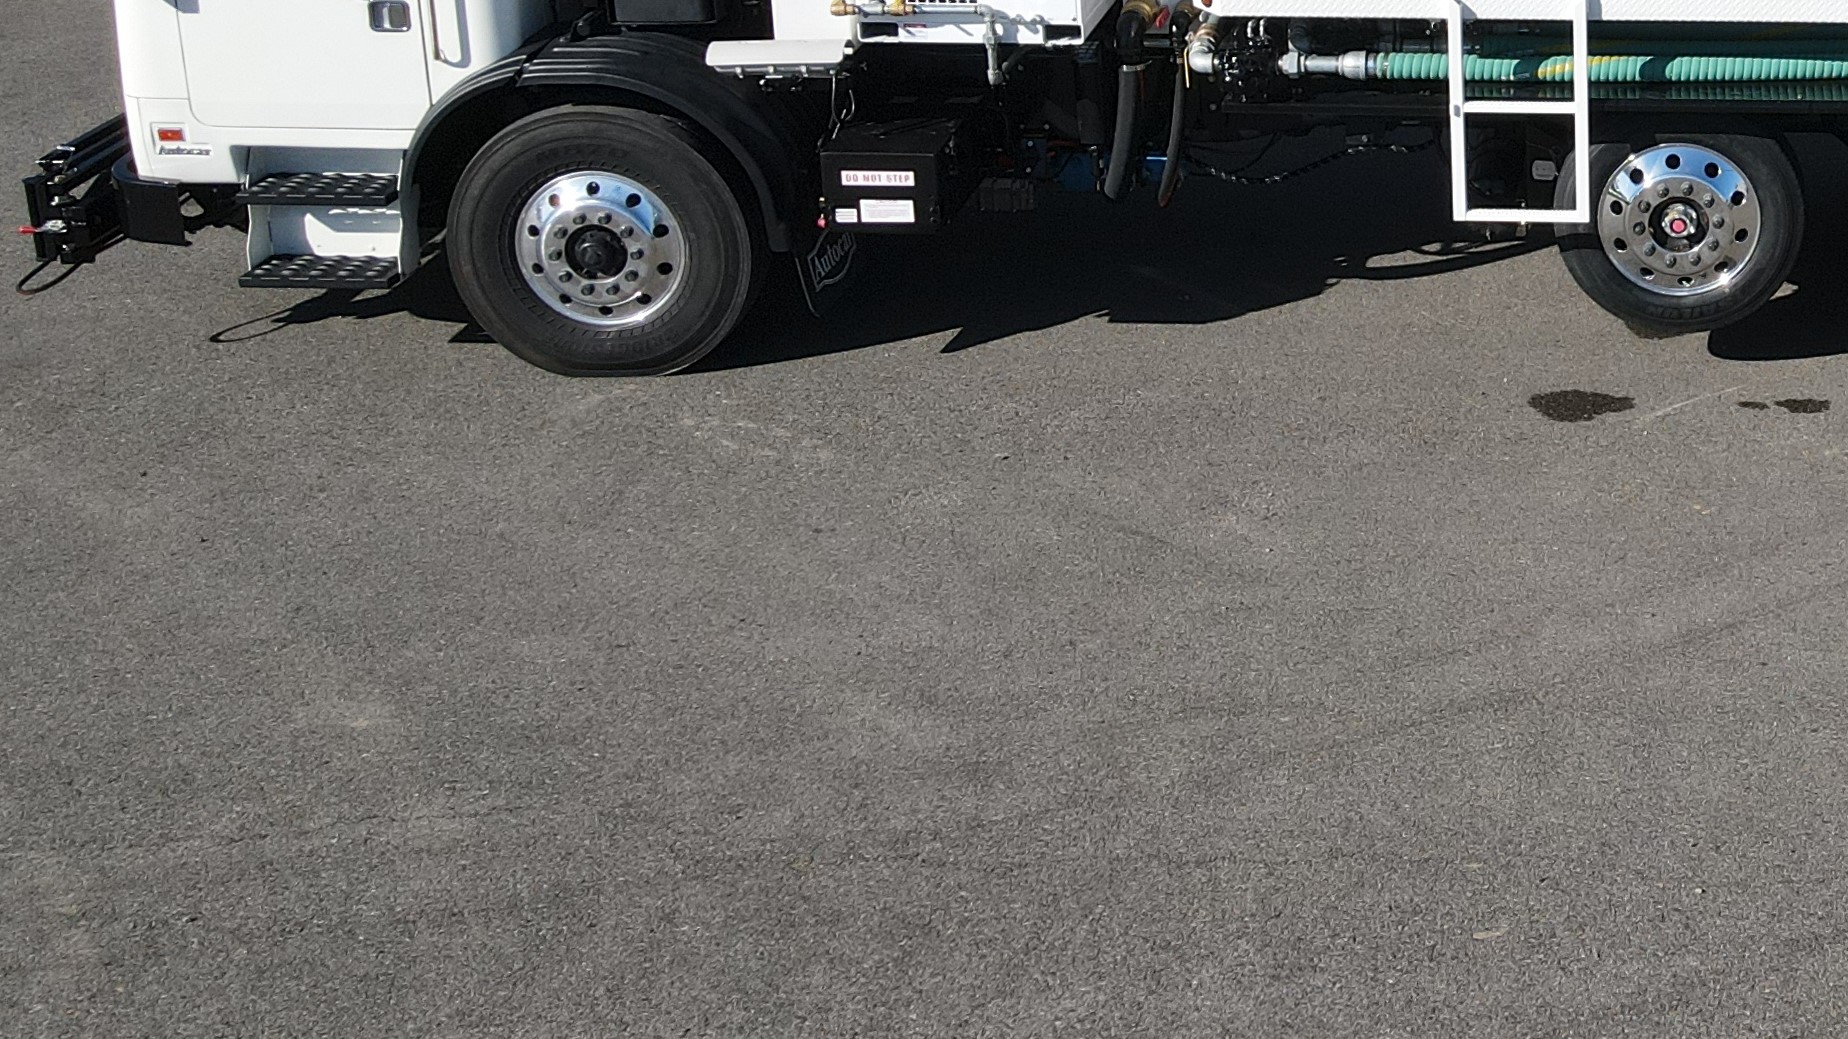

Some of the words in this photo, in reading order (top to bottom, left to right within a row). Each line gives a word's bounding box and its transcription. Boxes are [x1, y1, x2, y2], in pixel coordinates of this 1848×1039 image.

[845, 173, 859, 183] DO
[862, 173, 882, 183] NOT
[886, 173, 910, 184] STEP
